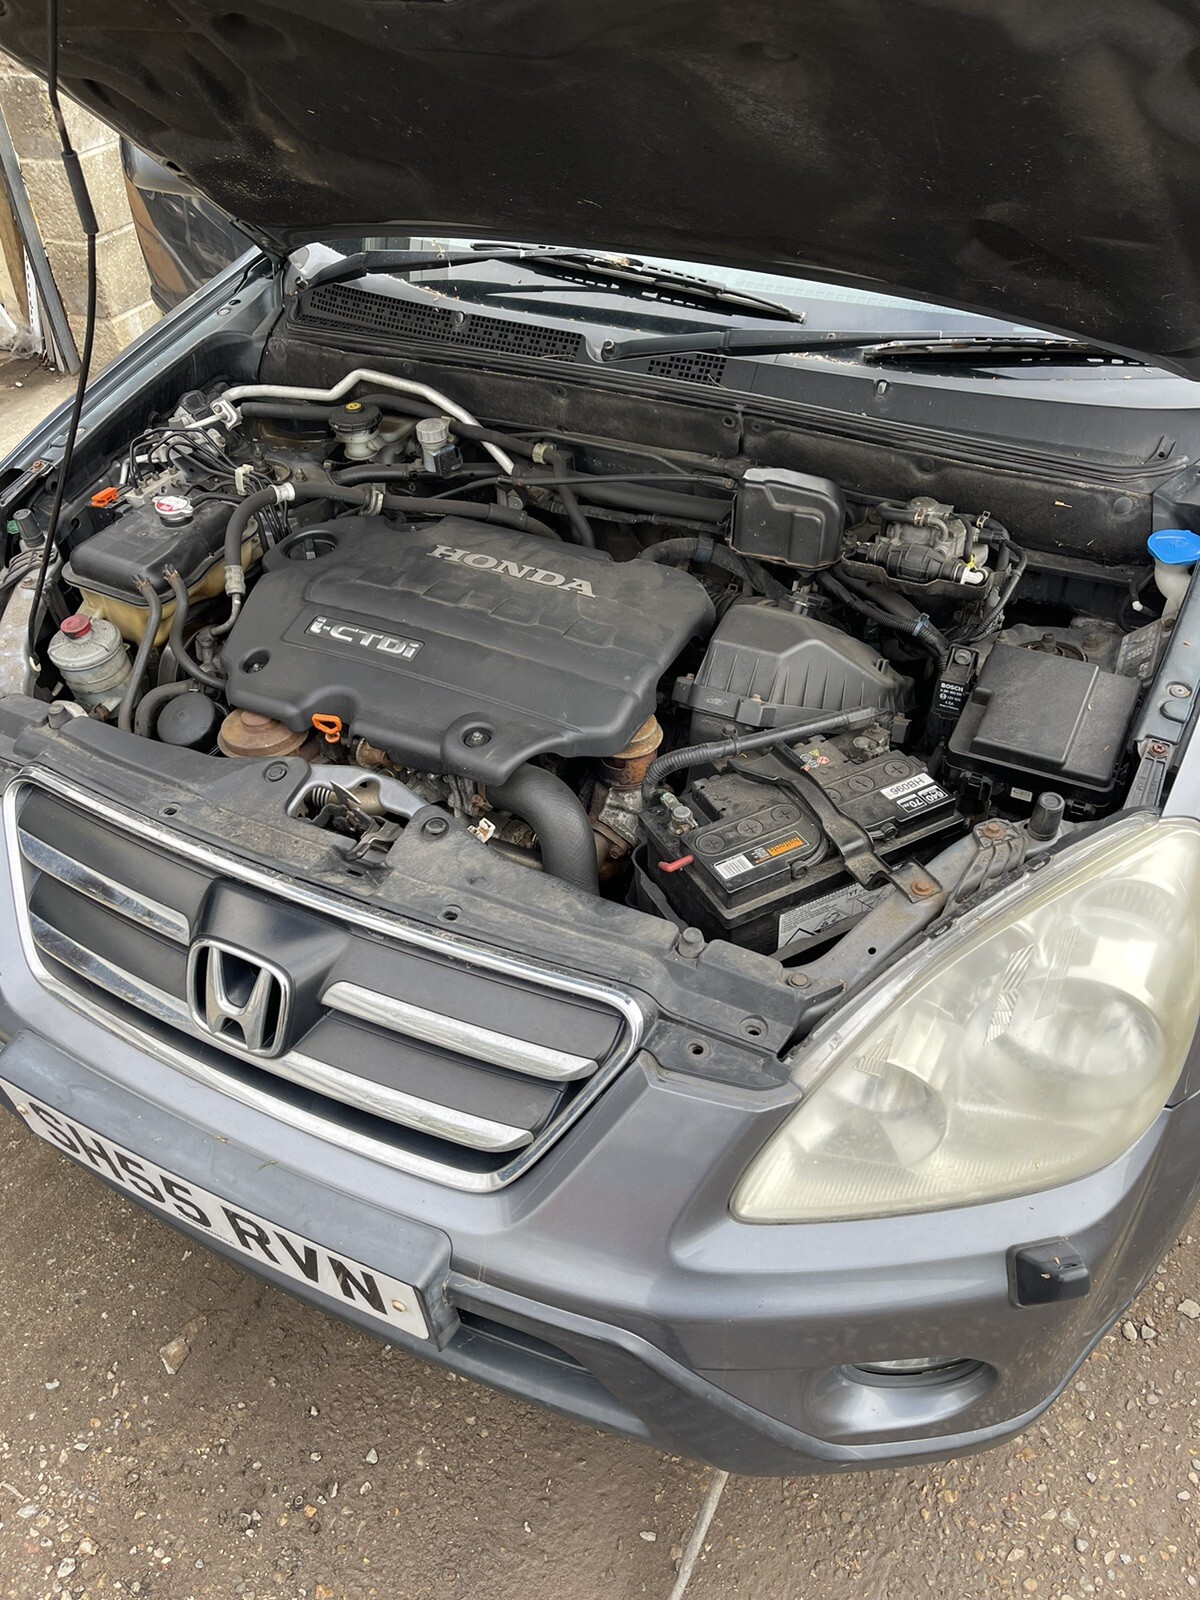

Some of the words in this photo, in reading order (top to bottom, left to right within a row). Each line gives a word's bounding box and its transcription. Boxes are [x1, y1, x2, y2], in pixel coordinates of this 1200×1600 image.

[426, 544, 597, 598] HONDA
[941, 682, 964, 692] BOSCH
[890, 777, 925, 795] HB096
[28, 1101, 212, 1228] SH55
[218, 1206, 389, 1316] RVN
